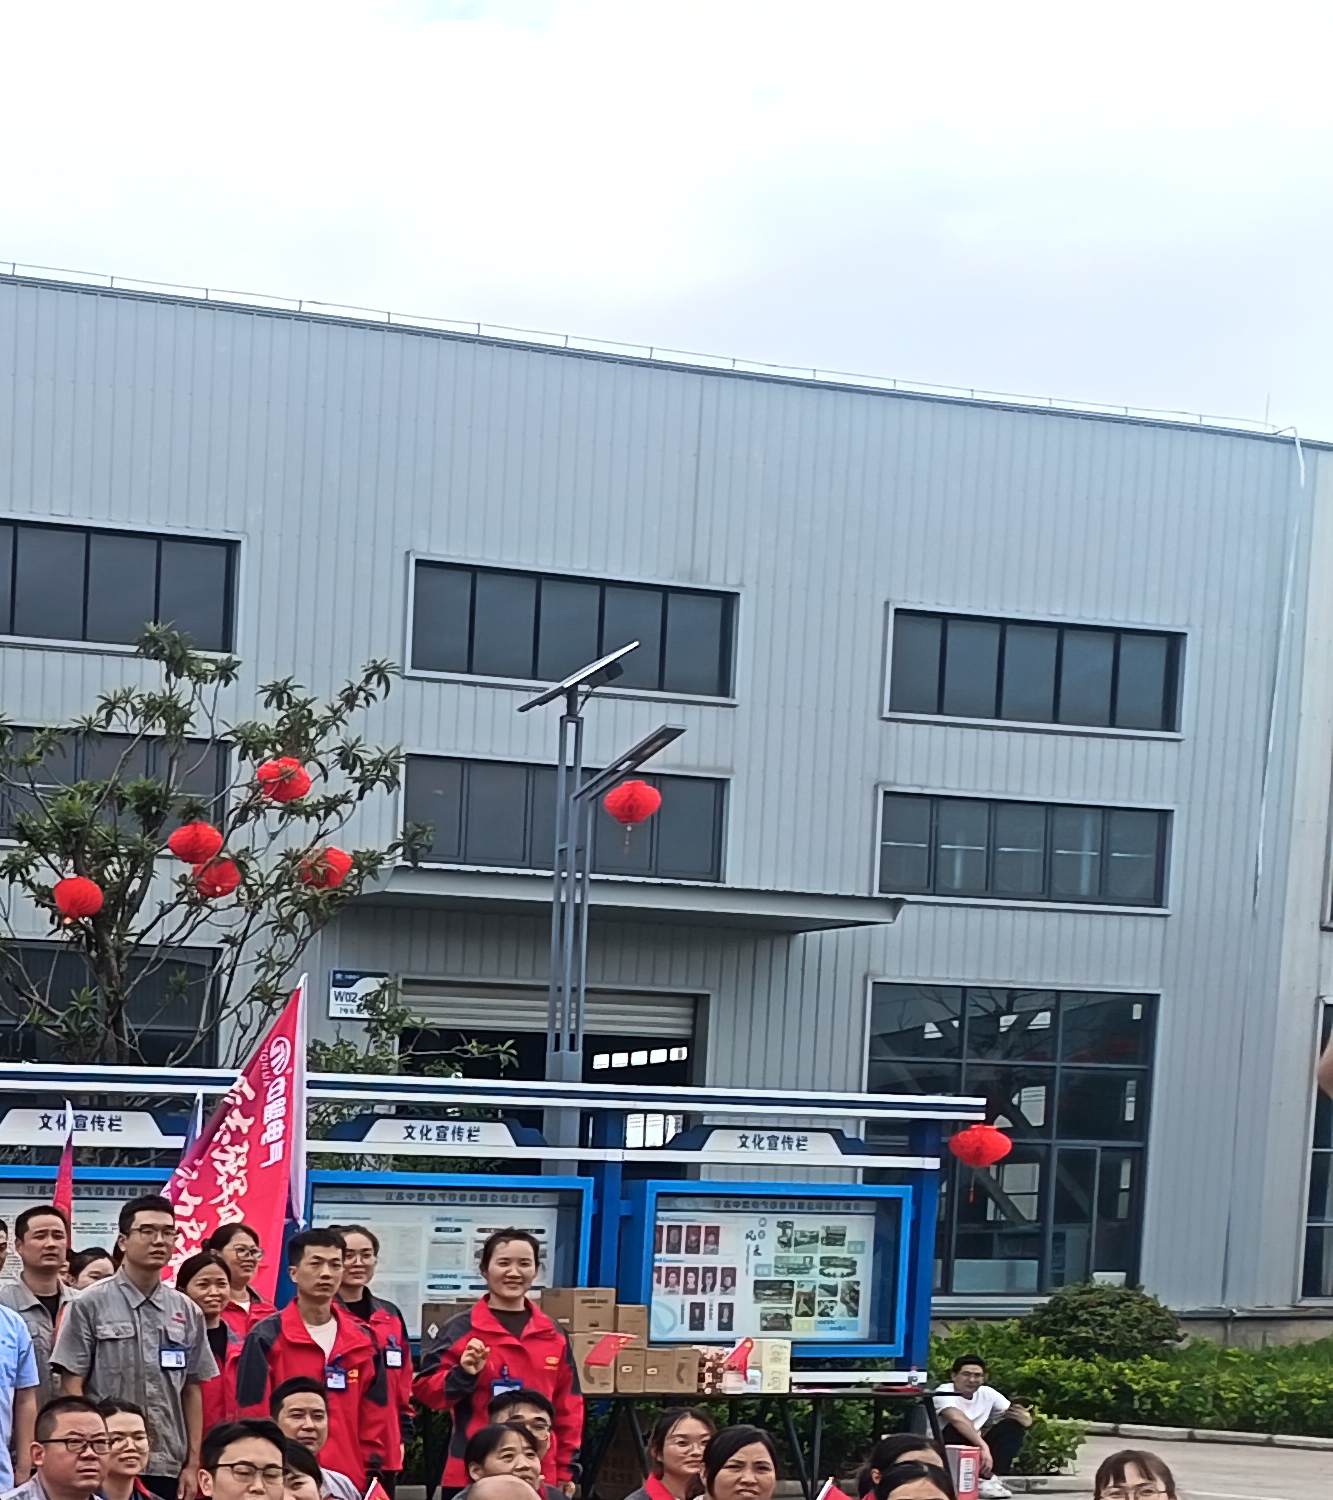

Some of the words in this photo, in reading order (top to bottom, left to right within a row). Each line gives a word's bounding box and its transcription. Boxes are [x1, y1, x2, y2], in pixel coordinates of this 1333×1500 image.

[39, 1113, 123, 1132] 文化宣传栏
[260, 1075, 287, 1168] 中盟电气
[402, 1124, 481, 1142] 文化宣传栏
[737, 1133, 809, 1151] 文化宣传栏
